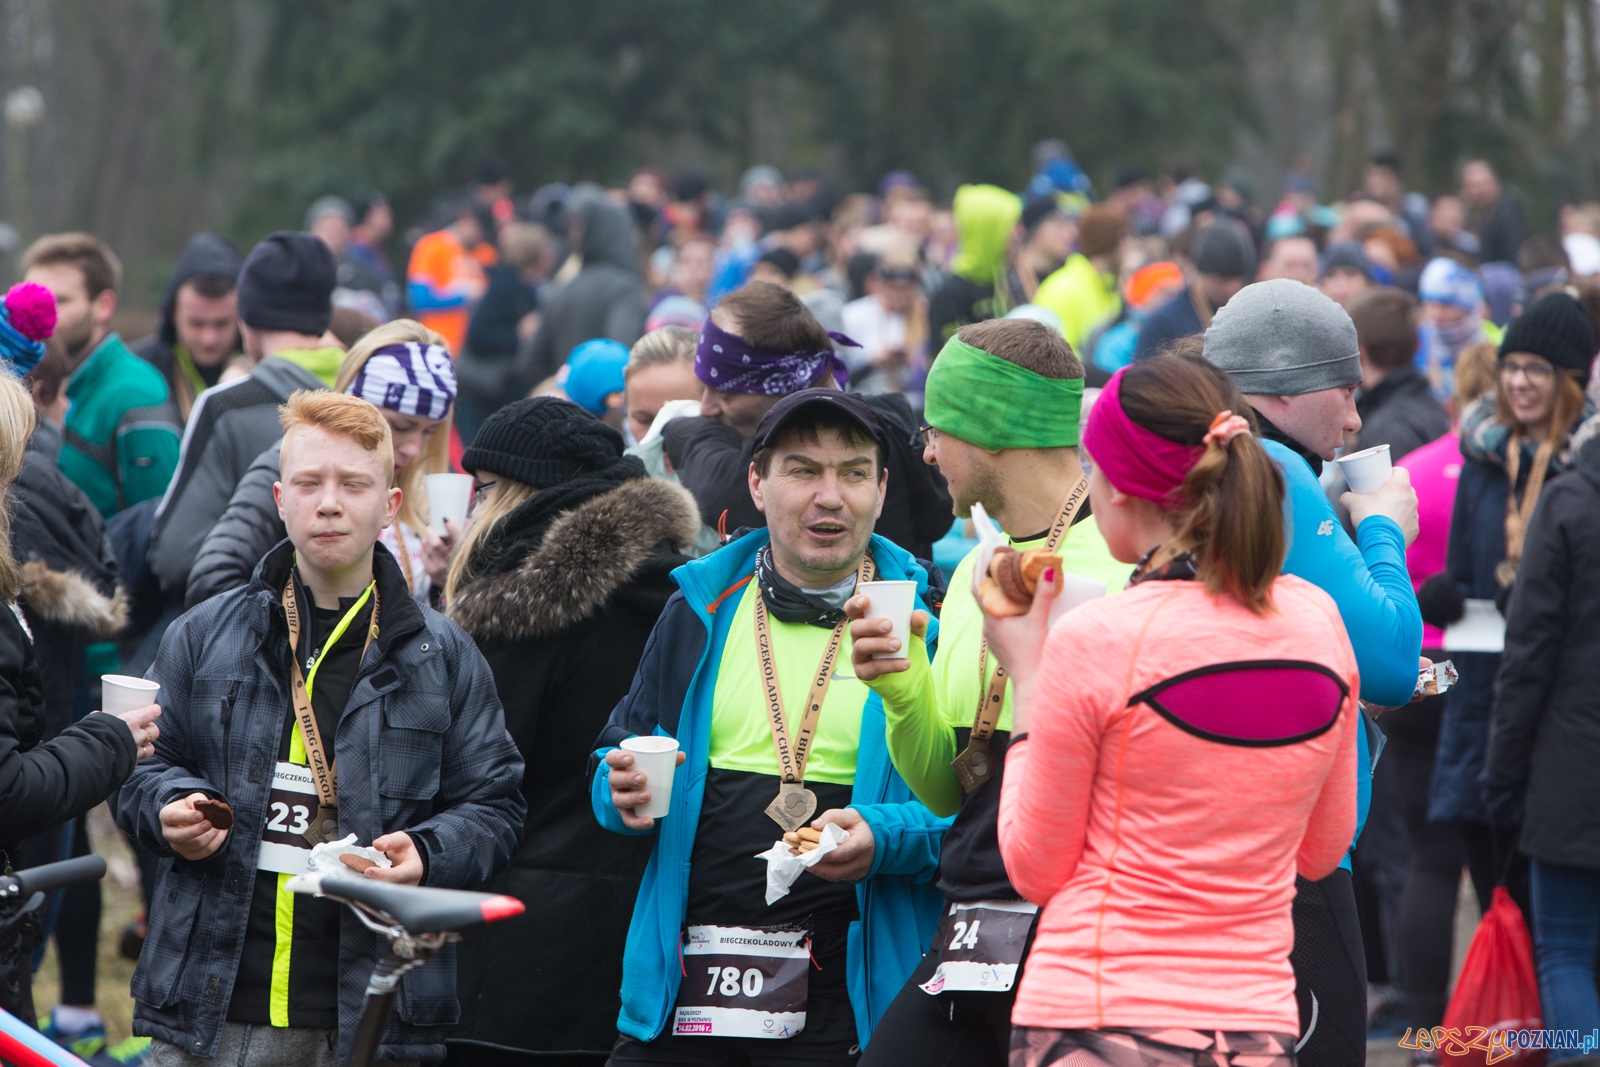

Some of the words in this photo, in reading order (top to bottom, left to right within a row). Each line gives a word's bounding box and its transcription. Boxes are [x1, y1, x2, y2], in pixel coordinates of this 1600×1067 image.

[1048, 479, 1088, 551] CZEKOLADO
[287, 601, 297, 627] BIEG
[760, 633, 785, 733] CZEKOLADOWY
[301, 713, 318, 746] BIEG
[265, 801, 310, 835] 23
[948, 920, 981, 951] 24
[706, 966, 764, 998] 780
